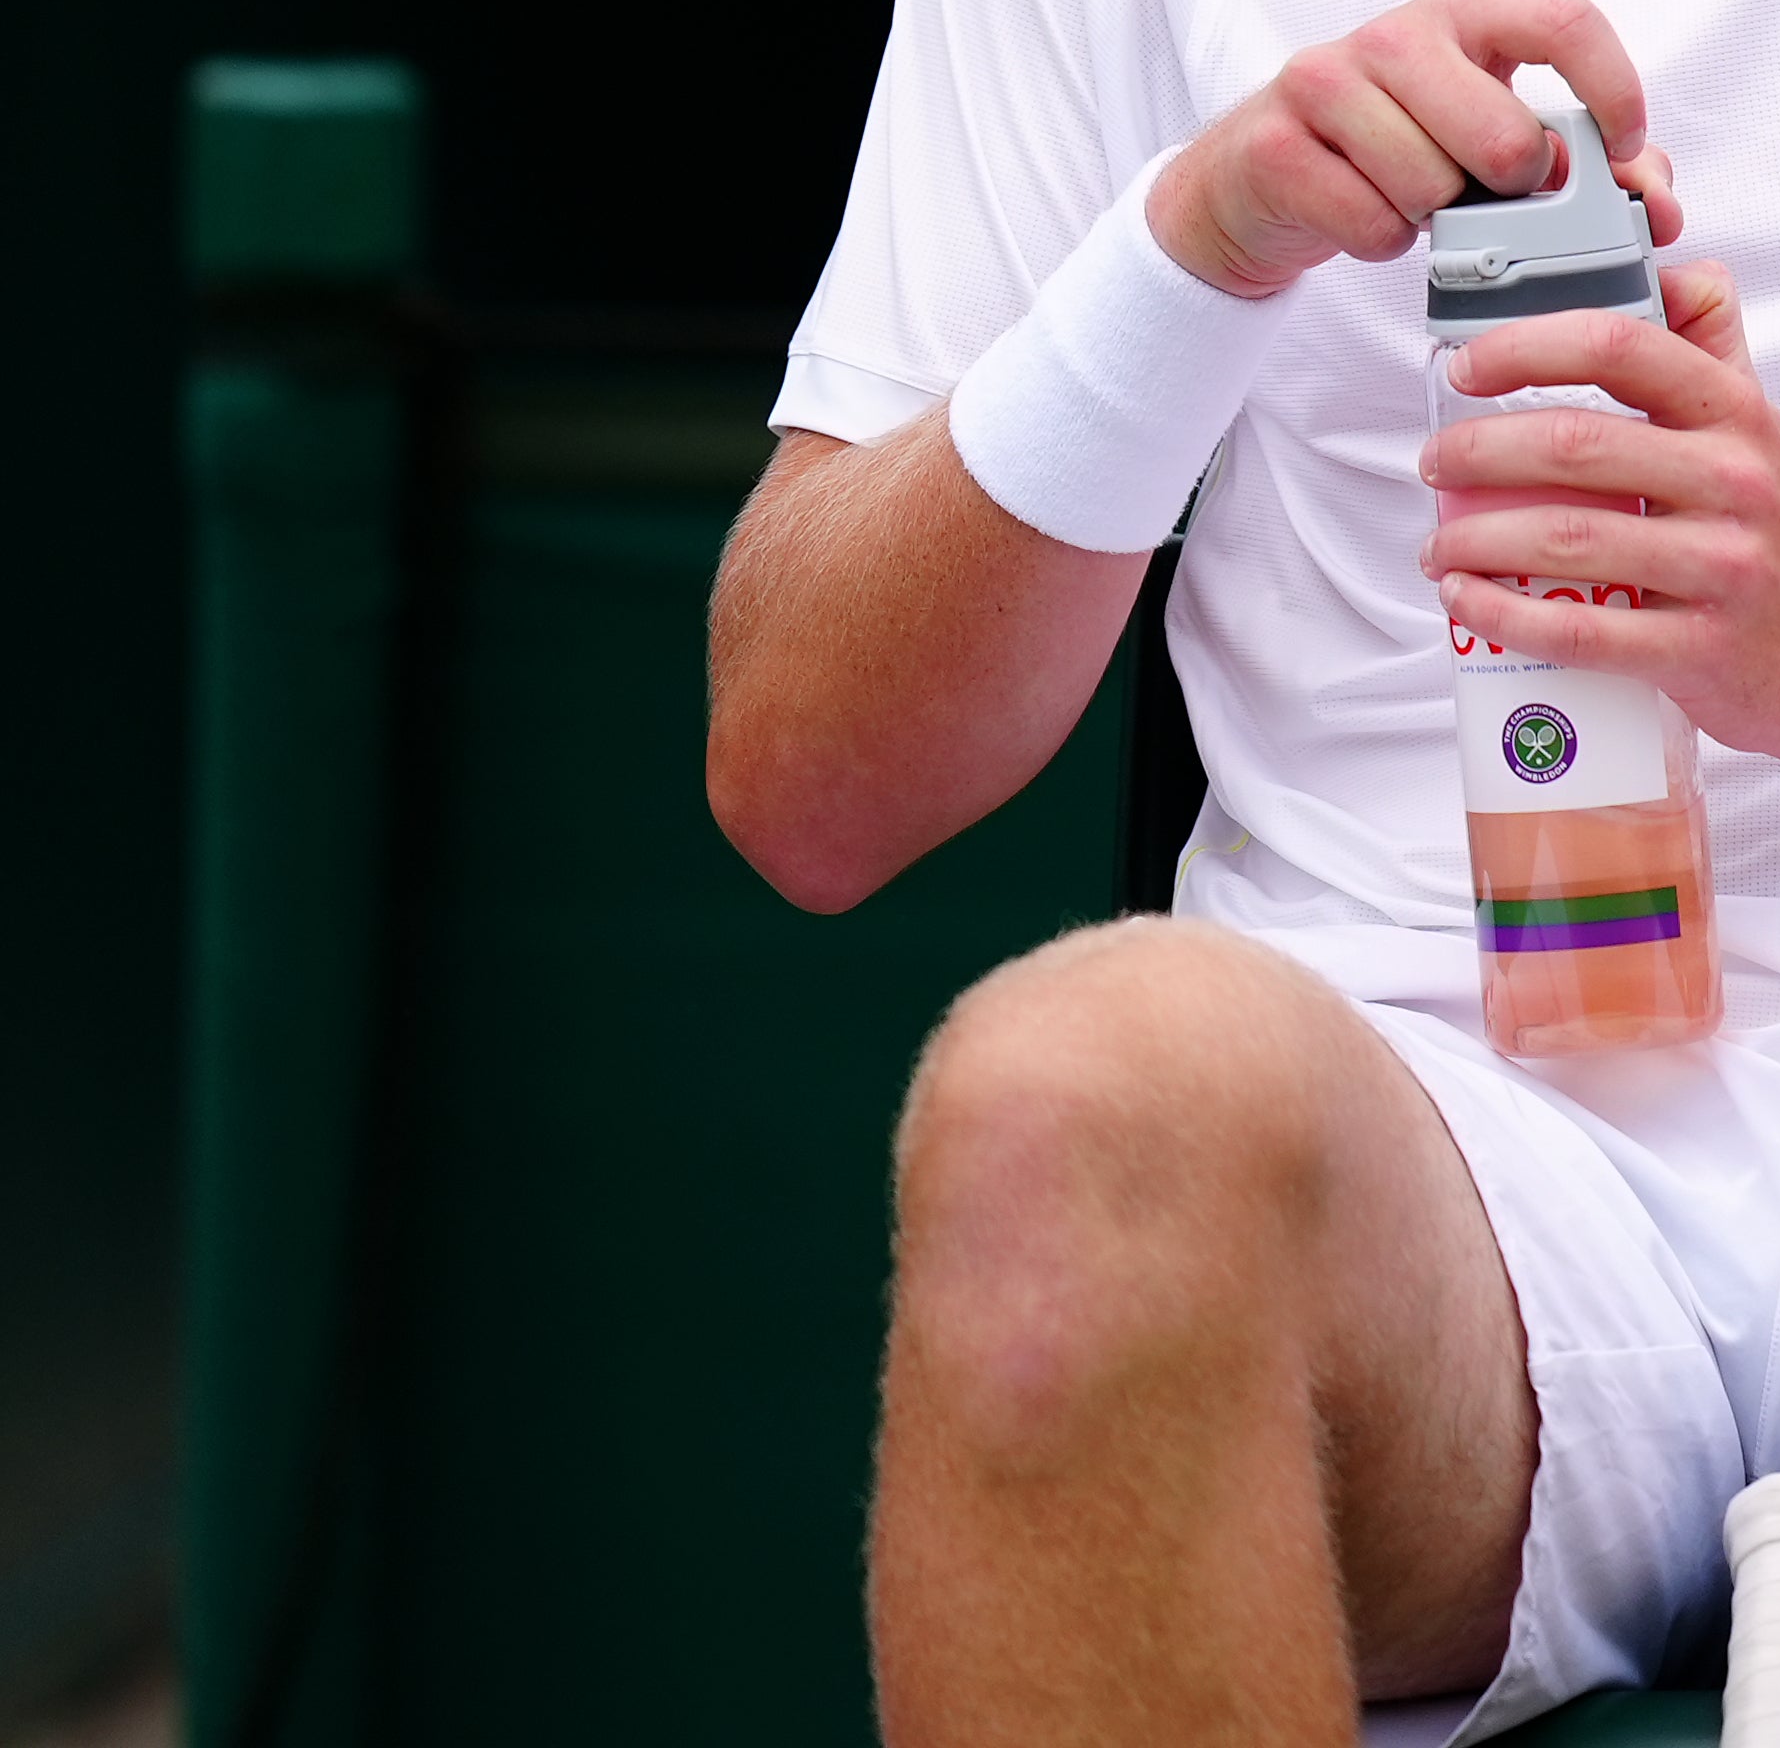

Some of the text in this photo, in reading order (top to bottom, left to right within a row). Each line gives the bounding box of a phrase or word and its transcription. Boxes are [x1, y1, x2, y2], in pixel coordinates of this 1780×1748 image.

[1503, 706, 1574, 743] THE CHAMPIONSHIPS
[1515, 761, 1568, 782] WIMBLEDON
